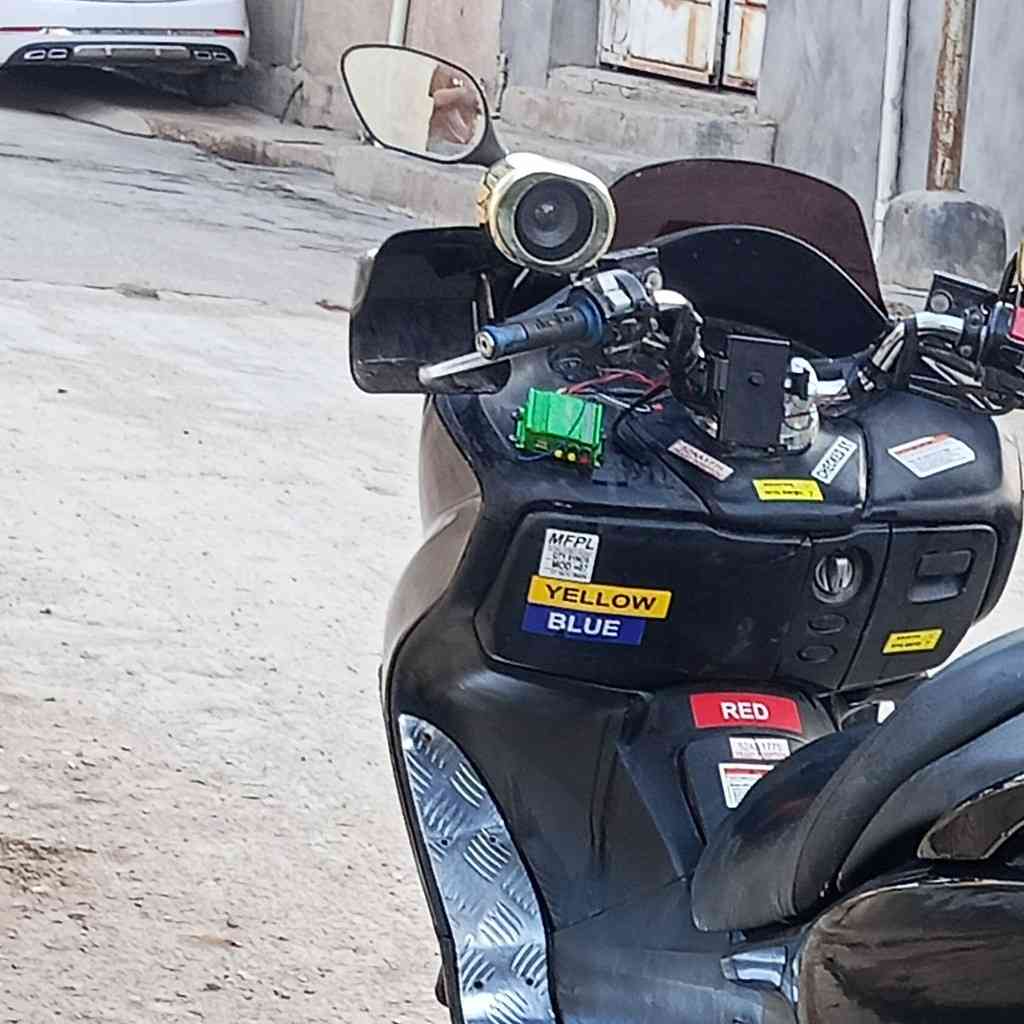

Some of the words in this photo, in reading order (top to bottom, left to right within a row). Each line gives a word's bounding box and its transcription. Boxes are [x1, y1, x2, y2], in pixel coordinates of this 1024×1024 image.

[548, 532, 595, 550] MFPL
[545, 583, 657, 611] YELLOW
[546, 611, 621, 637] BLUE
[720, 701, 770, 721] RED
